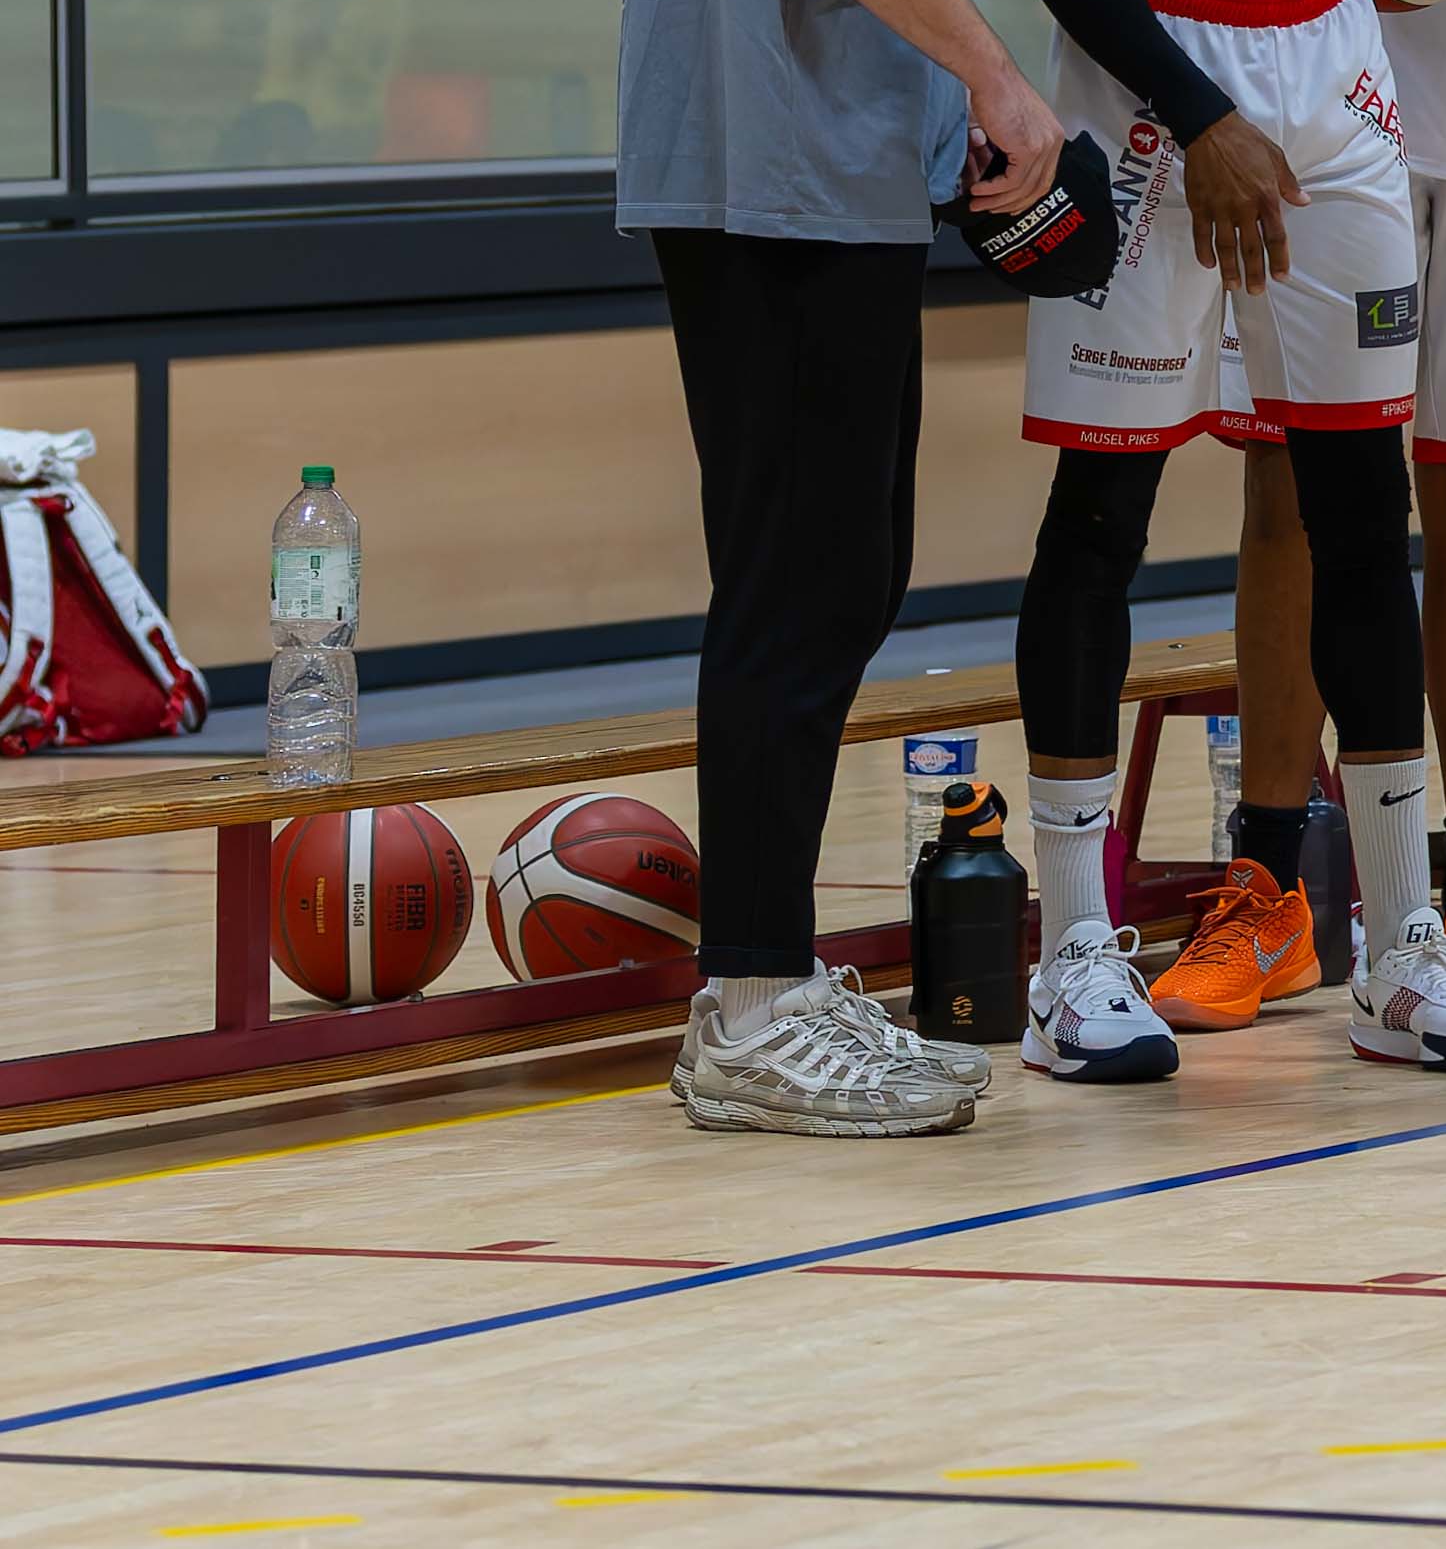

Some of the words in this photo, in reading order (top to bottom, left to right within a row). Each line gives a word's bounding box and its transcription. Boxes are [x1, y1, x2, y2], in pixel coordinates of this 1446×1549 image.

[981, 187, 1069, 253] BASKETBALL
[1034, 208, 1086, 255] MUSEL
[1071, 343, 1107, 366] SERGE
[1109, 350, 1187, 372] BONENBERGER
[1080, 431, 1124, 446] MUSEL
[1128, 433, 1160, 446] PIKES
[639, 850, 697, 887] olten
